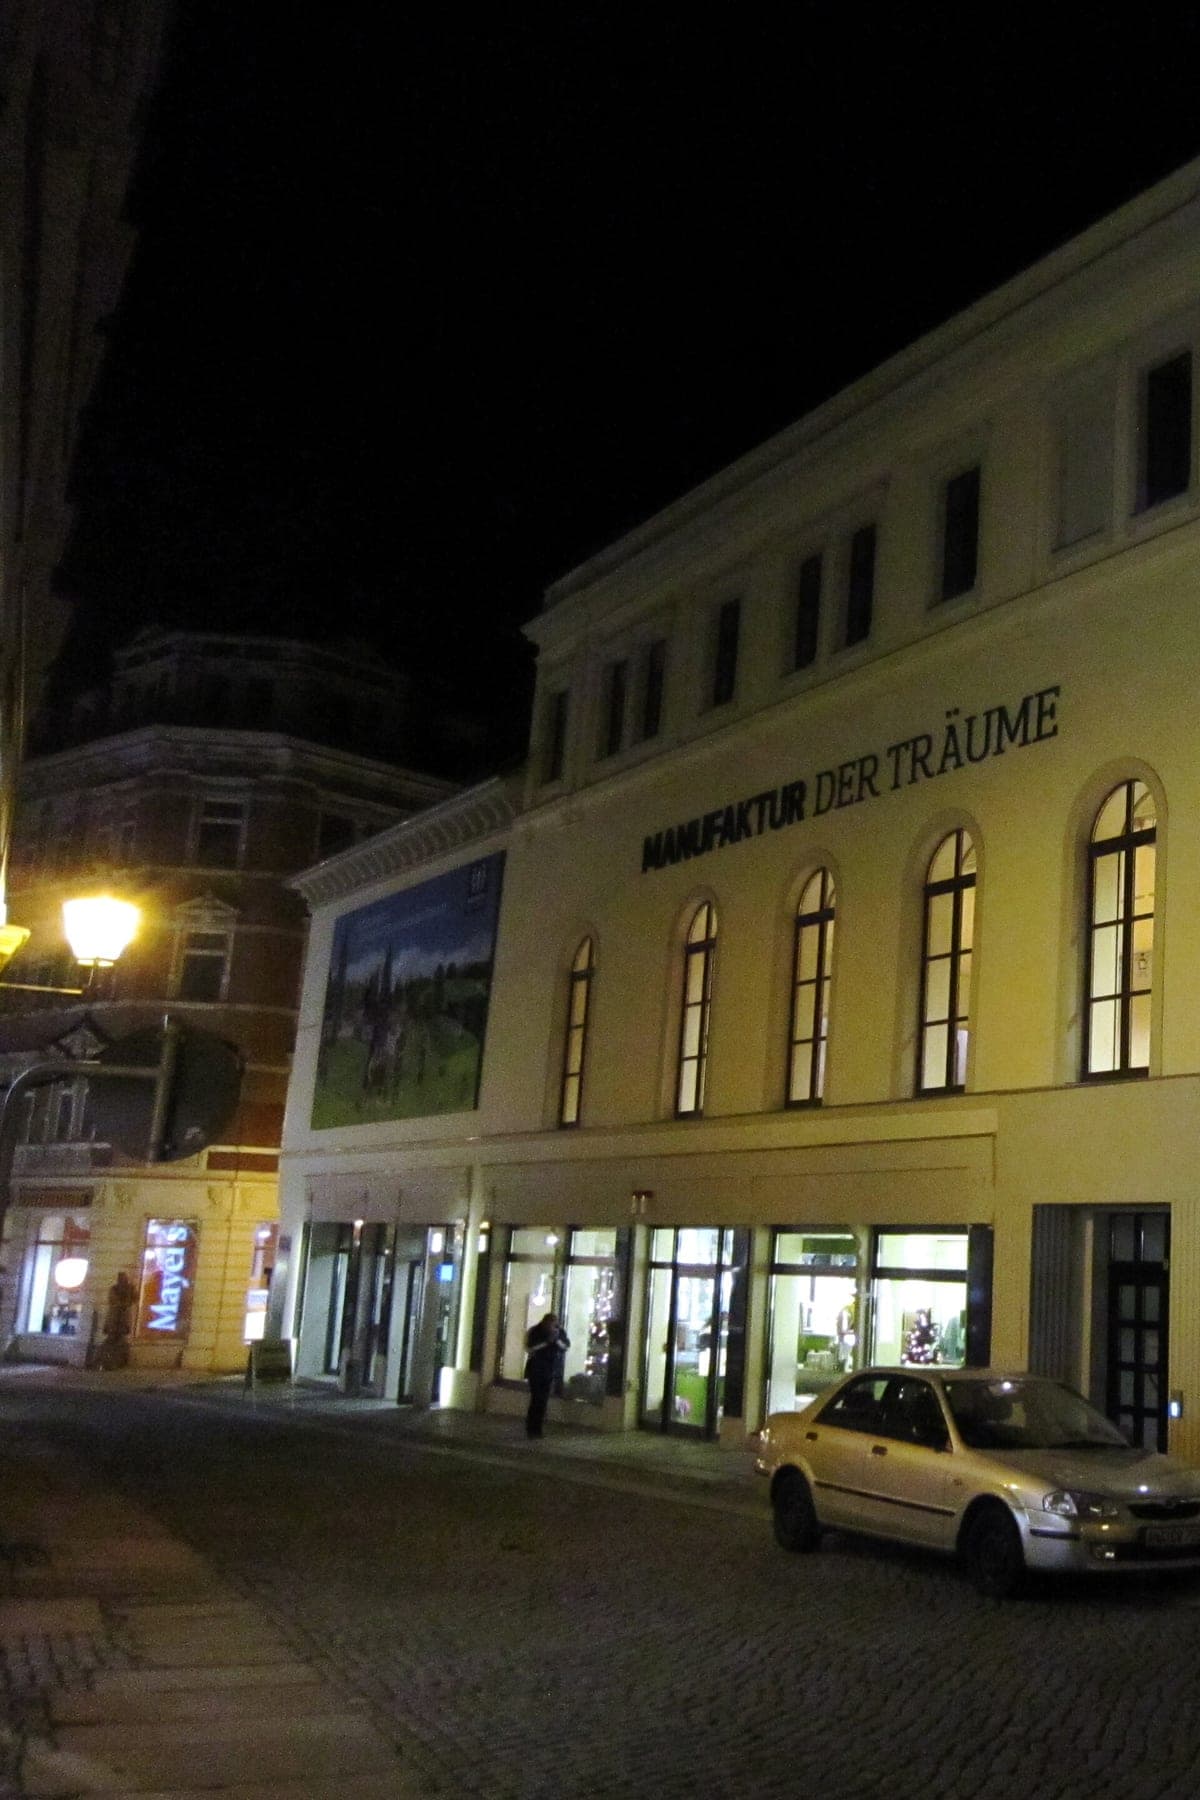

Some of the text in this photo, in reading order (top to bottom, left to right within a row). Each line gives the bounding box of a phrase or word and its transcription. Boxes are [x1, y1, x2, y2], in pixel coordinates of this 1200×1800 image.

[641, 685, 1061, 874] MANUFAKTUR DER TRÄUME
